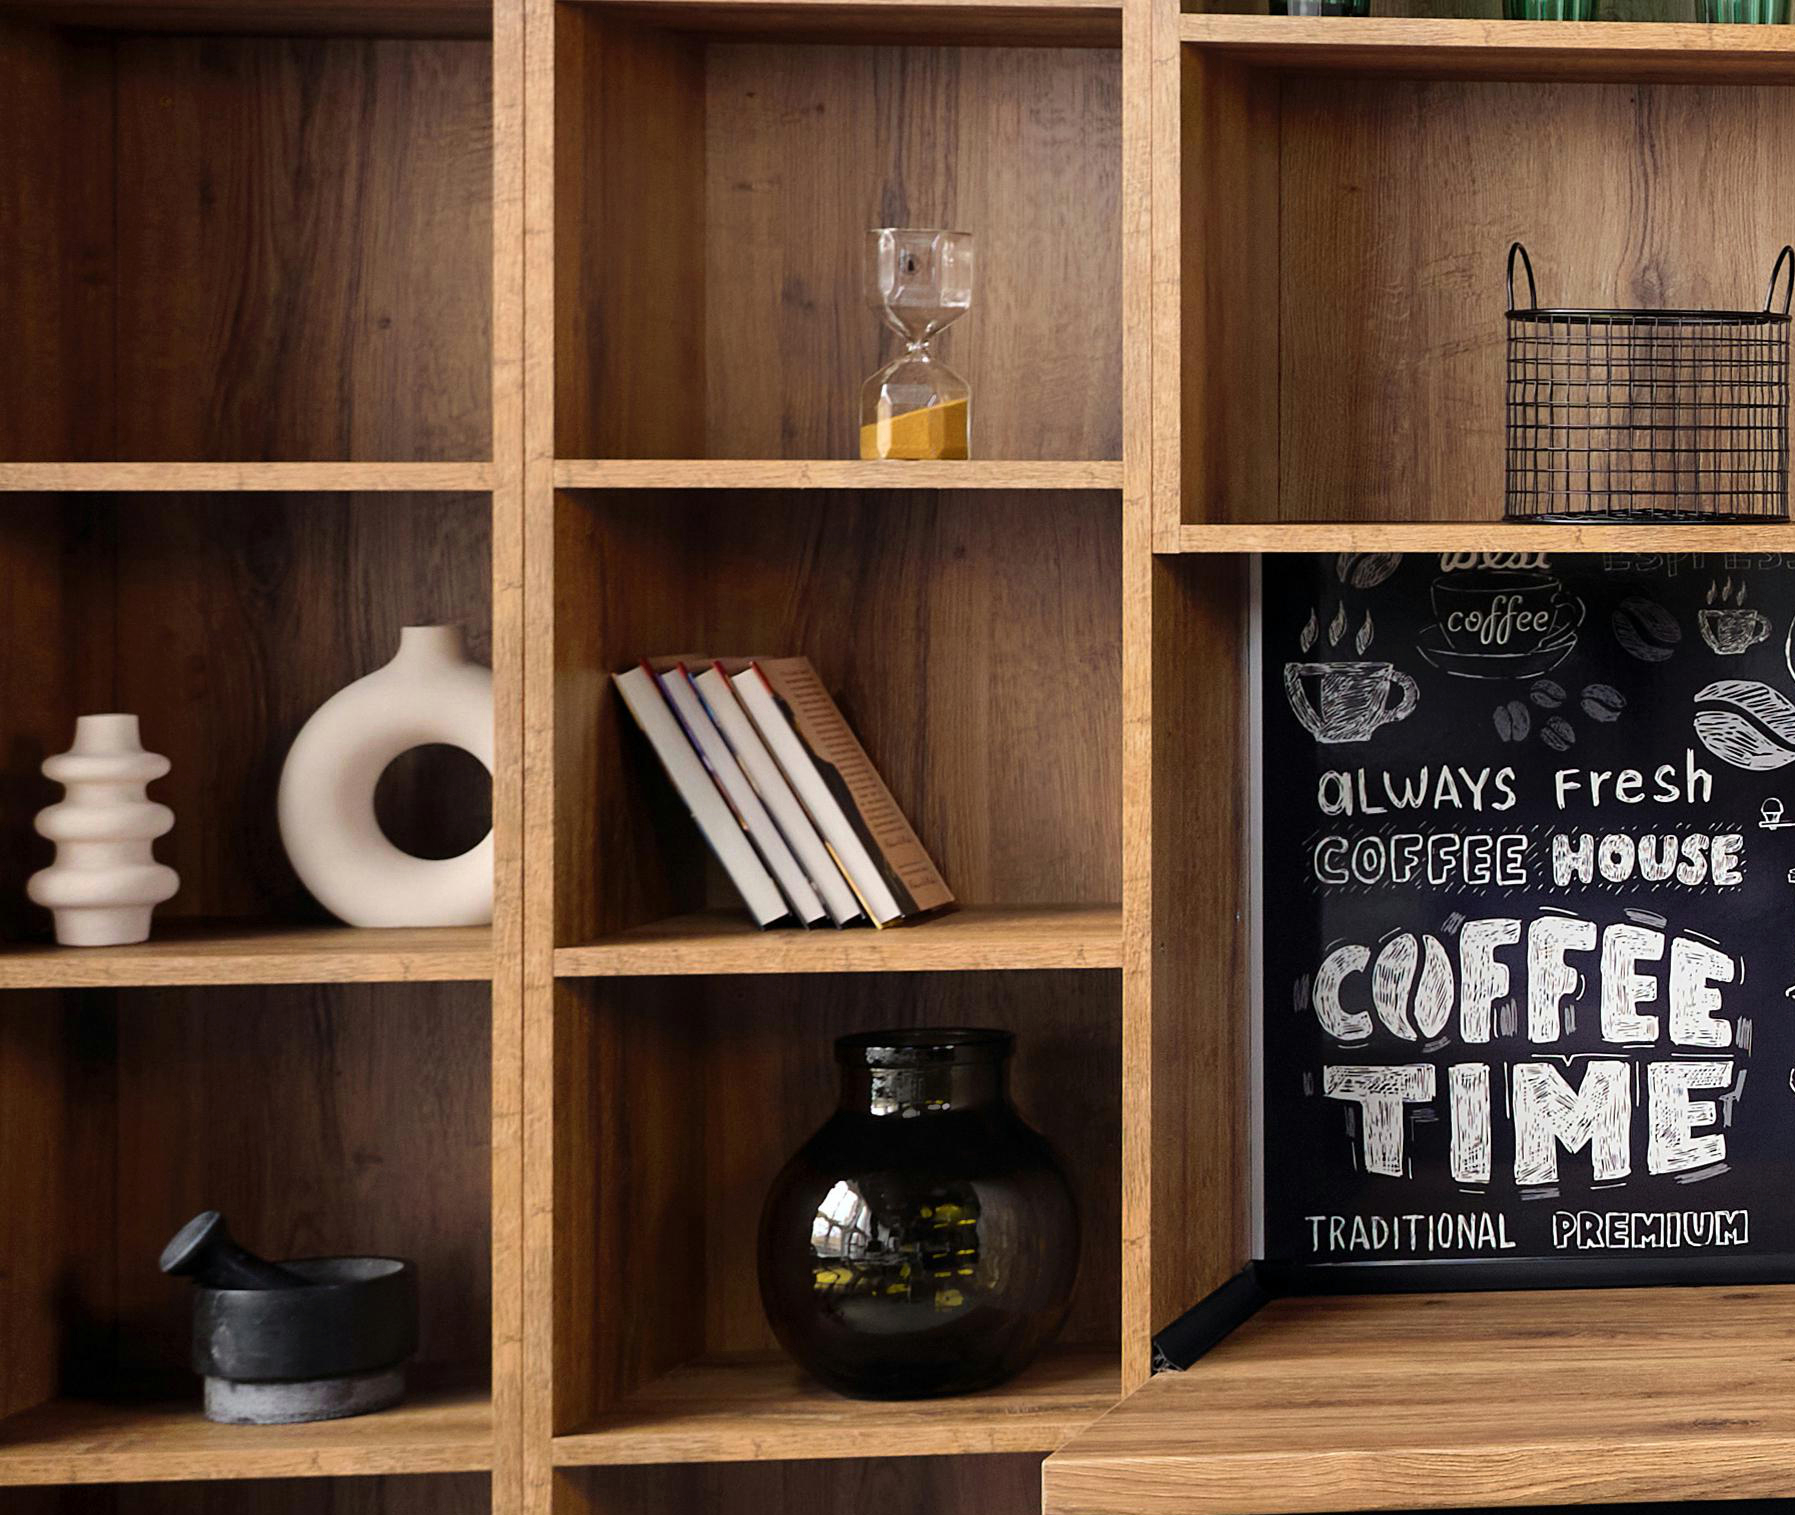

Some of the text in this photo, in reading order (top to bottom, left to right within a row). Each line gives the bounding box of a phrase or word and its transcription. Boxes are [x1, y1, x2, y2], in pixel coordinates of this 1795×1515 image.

[1447, 594, 1550, 646] coffee
[1312, 832, 1745, 888] COFFEE HOUSE
[1312, 916, 1736, 1048] COFFEE
[1321, 1059, 1735, 1187] TIME
[1304, 1208, 1750, 1253] TRADITIONAL PREMIUM
